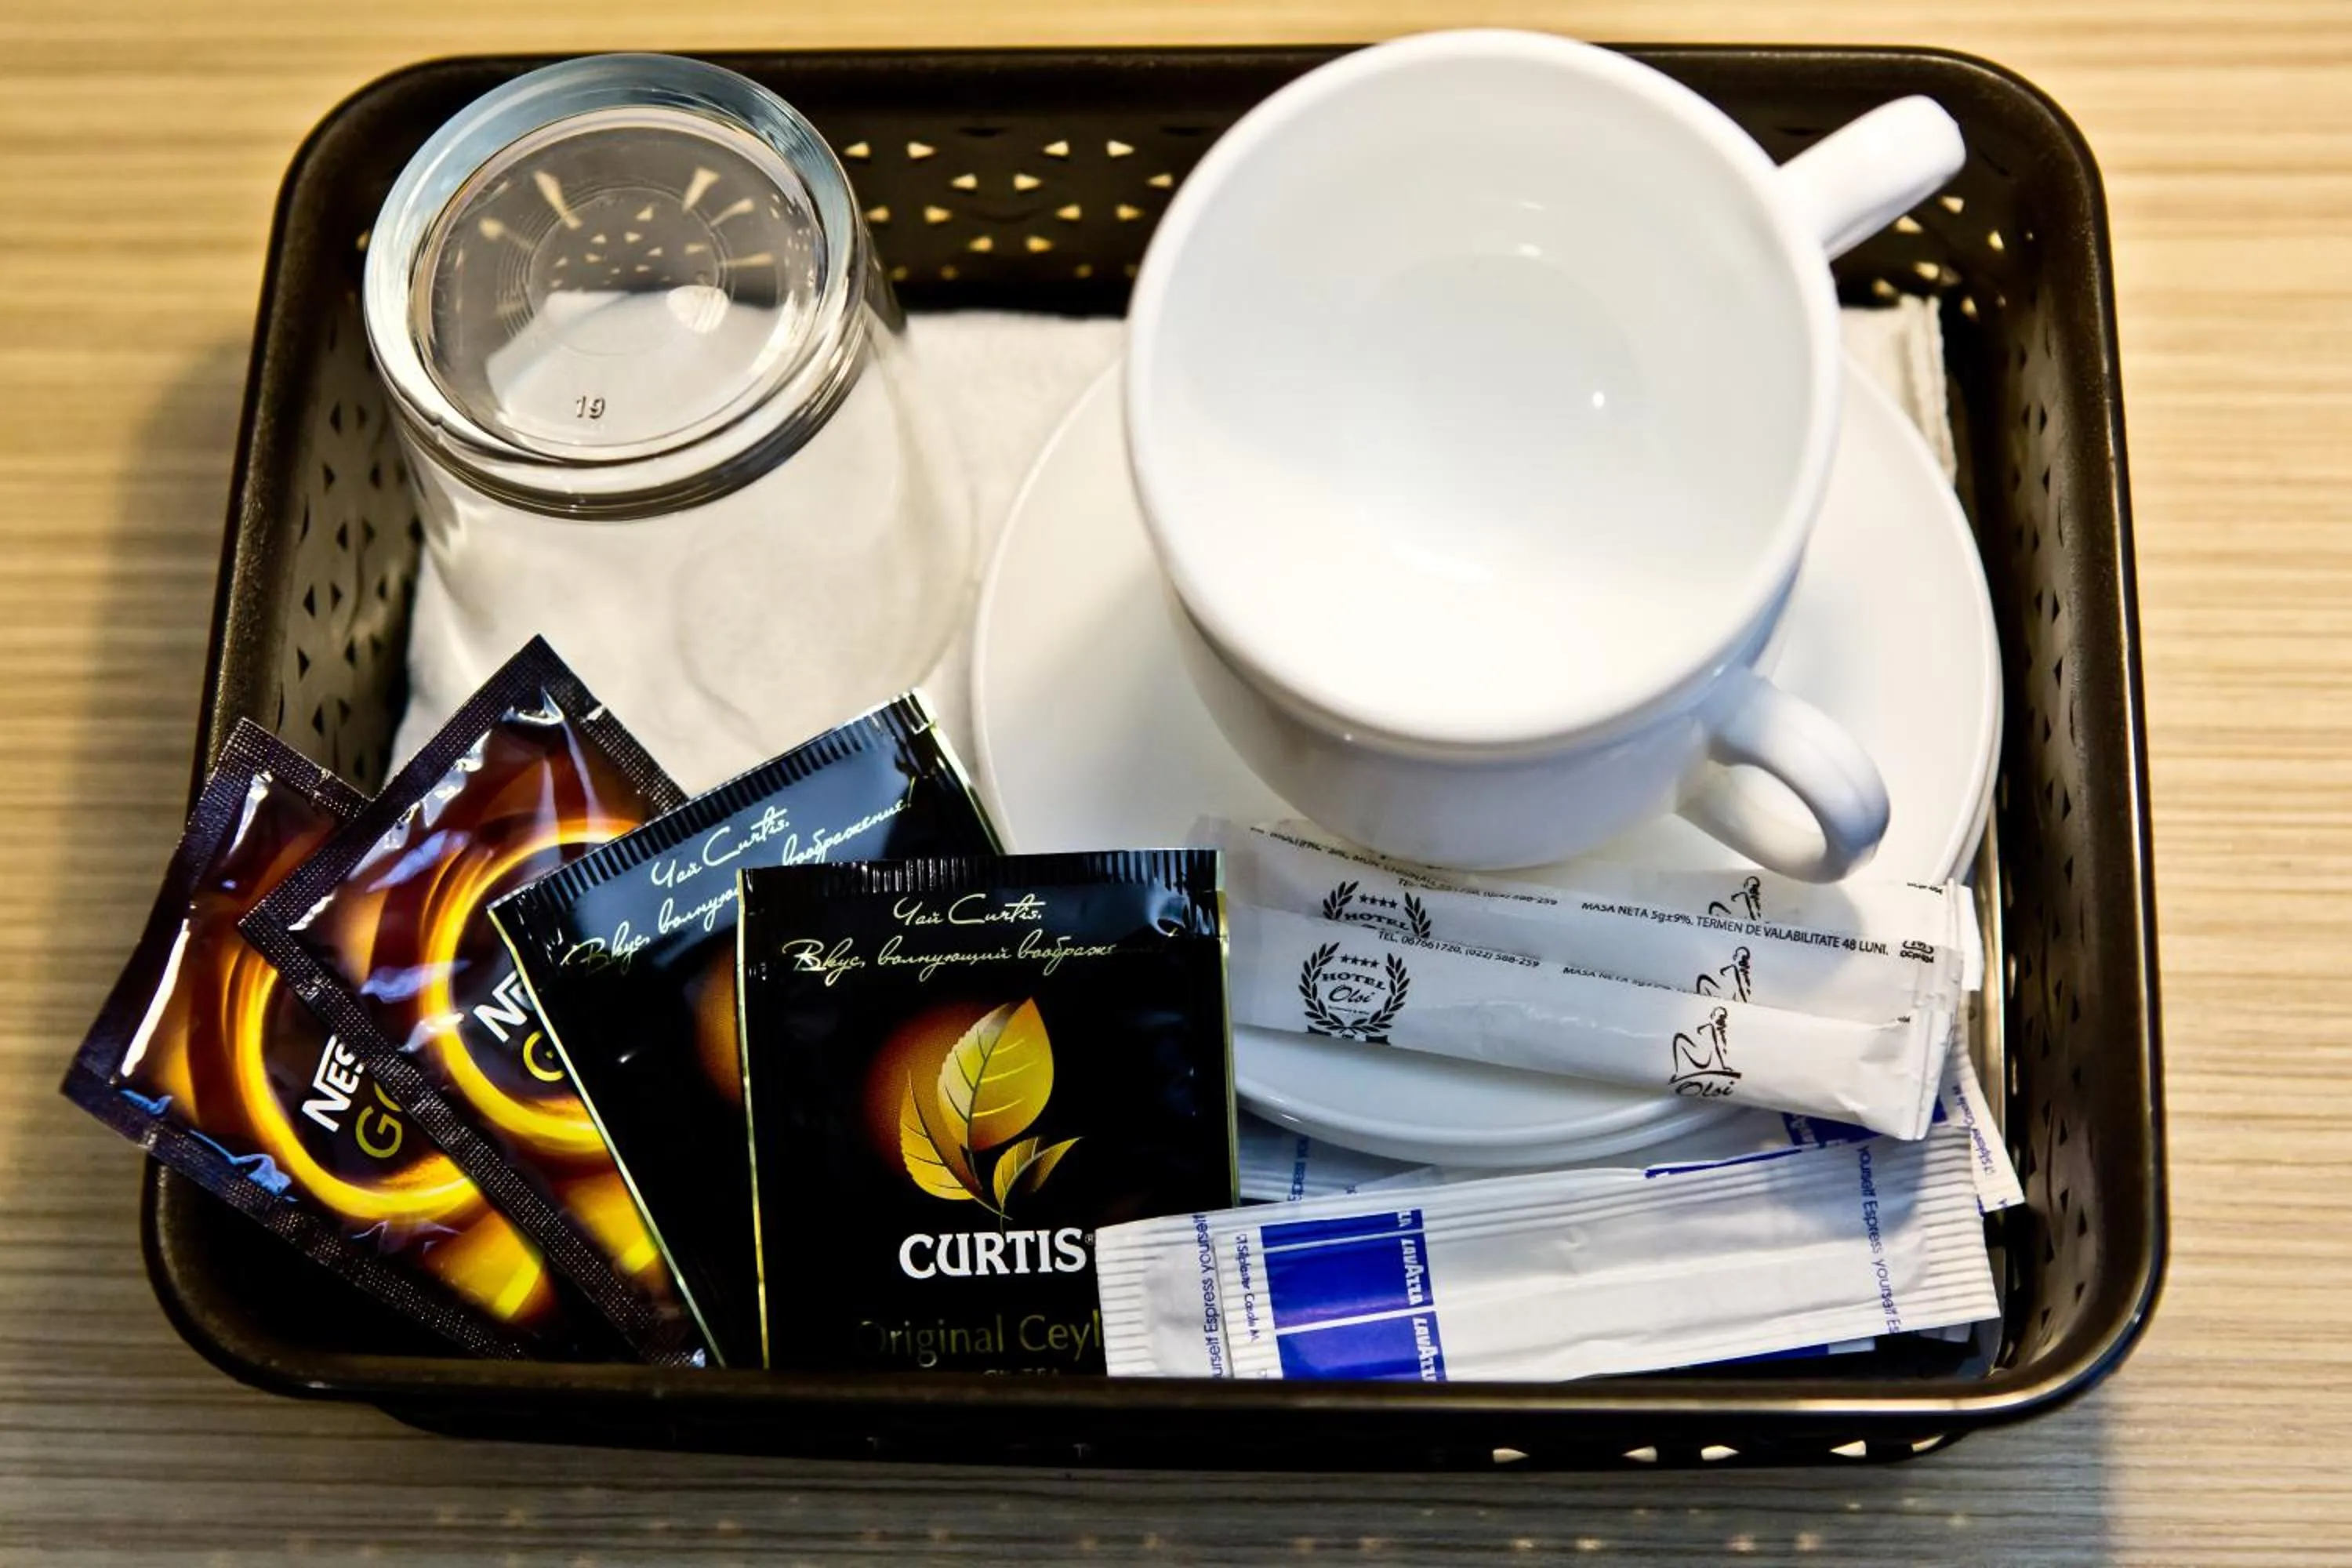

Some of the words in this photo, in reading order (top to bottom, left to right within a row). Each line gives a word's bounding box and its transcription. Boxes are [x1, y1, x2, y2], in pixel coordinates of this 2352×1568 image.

[575, 396, 606, 419] 19
[658, 898, 739, 932] волную
[893, 896, 943, 926] Чай
[1344, 912, 1410, 931] HOTEL
[1581, 902, 1615, 913] MASA
[1617, 905, 1649, 918] NETA
[1697, 915, 1742, 932] TERMEN
[1746, 925, 1762, 937] DE
[1763, 926, 1840, 948] VALABILITATE
[1842, 939, 1856, 951] 48
[1859, 940, 1889, 956] LUNI.
[1322, 971, 1387, 991] HOTEL
[1857, 1145, 1876, 1197] yourself
[1192, 1214, 1215, 1274] yourself
[1863, 1200, 1883, 1255] Espress
[1203, 1276, 1221, 1333] Espress
[1871, 1258, 1899, 1316] yourself
[856, 1313, 1004, 1368] Original
[1018, 1308, 1102, 1363] Ceyl
[1203, 1336, 1224, 1377] urself
